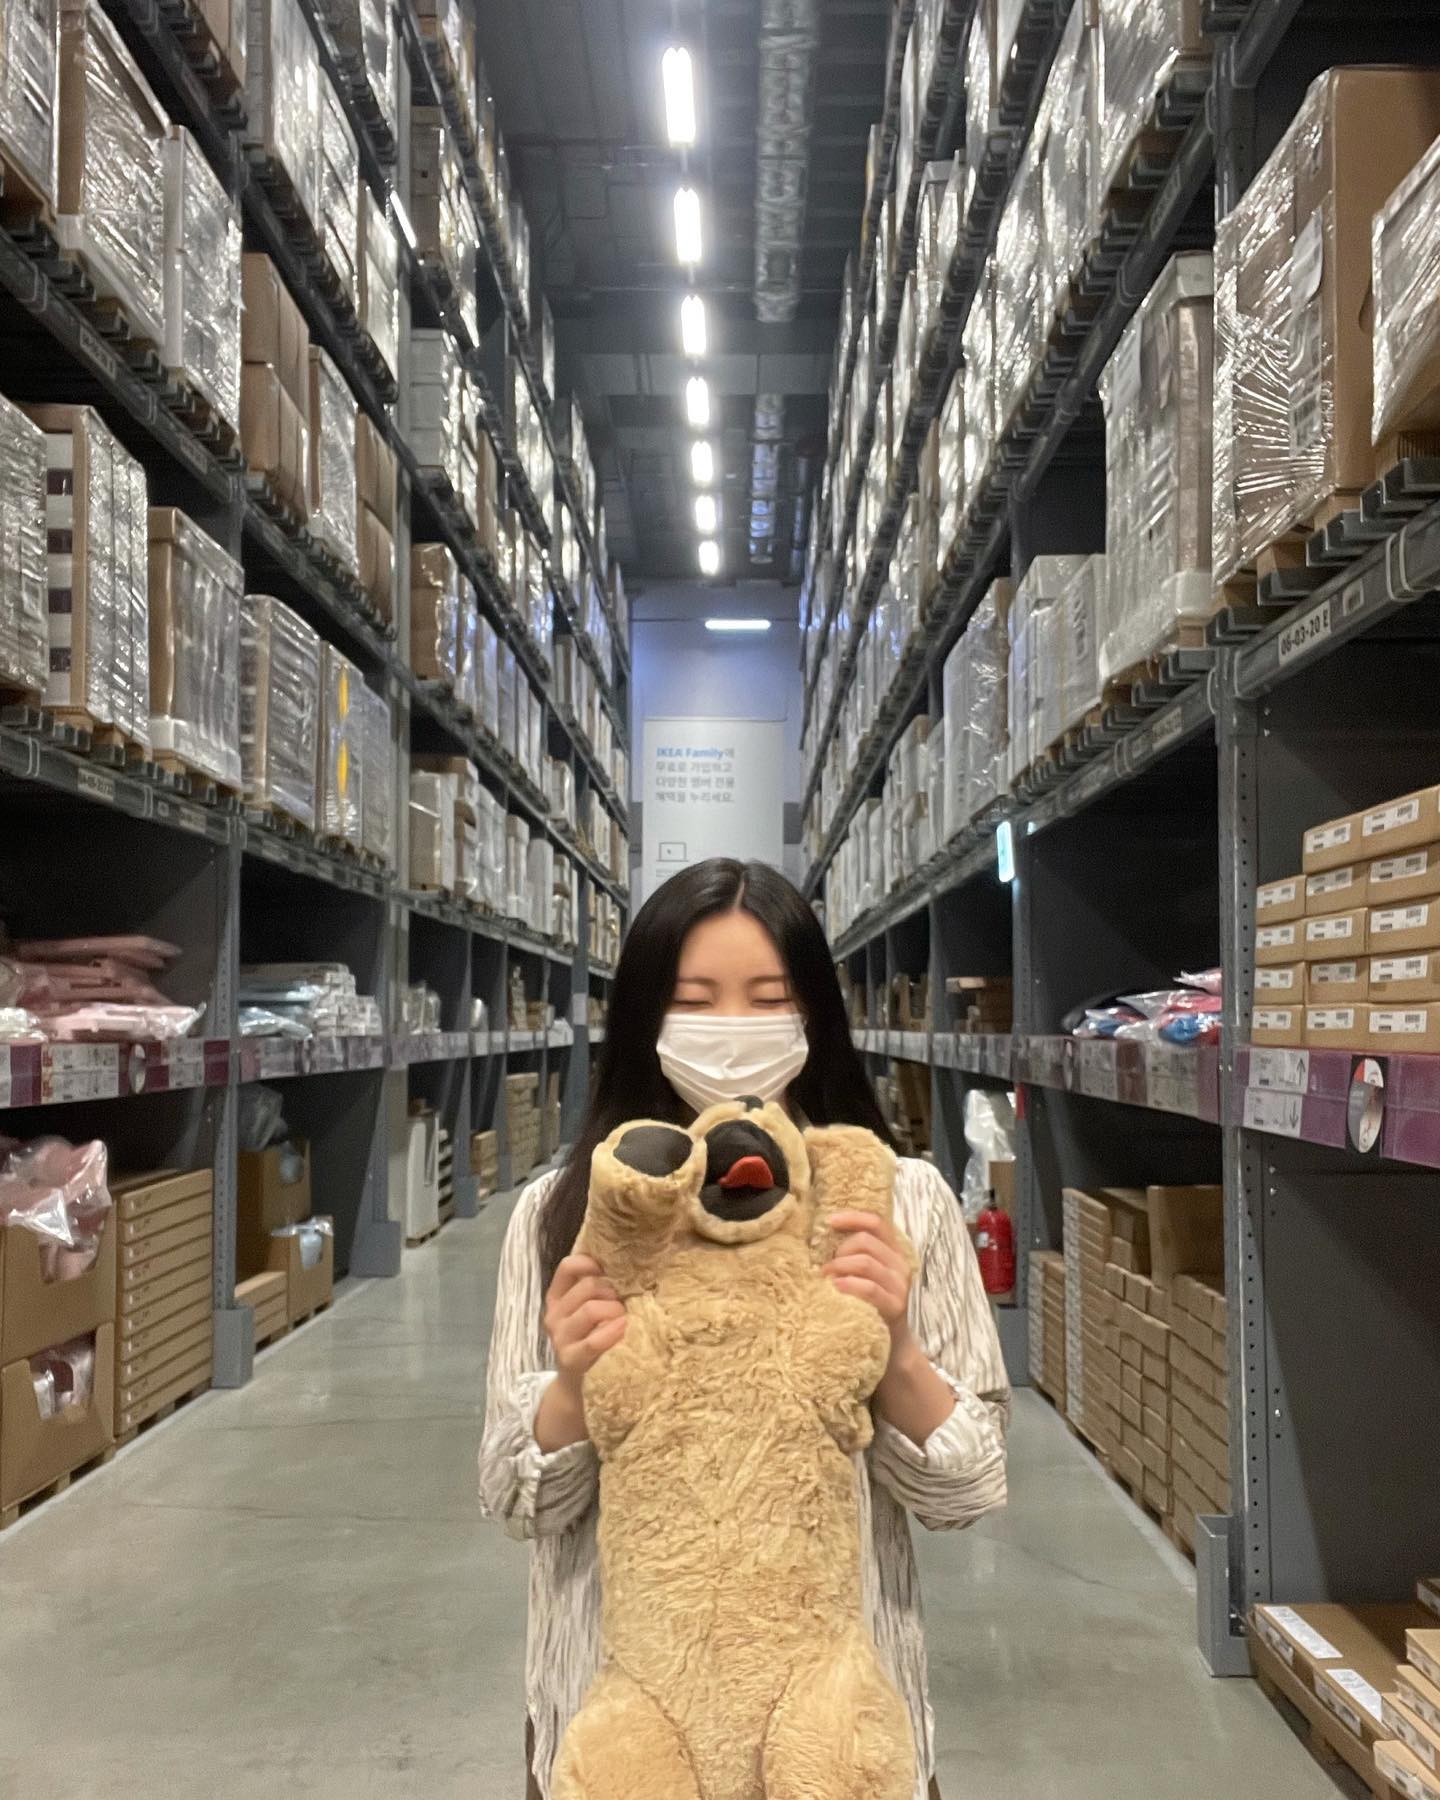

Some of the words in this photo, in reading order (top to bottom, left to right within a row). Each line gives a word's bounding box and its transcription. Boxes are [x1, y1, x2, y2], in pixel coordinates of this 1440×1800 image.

[656, 747, 683, 758] IKEA
[656, 761, 687, 772] 무료로
[690, 761, 732, 773] 가입하고
[656, 776, 687, 788] 다양한
[690, 776, 711, 788] 멤버
[715, 776, 735, 788] 전용
[655, 791, 686, 803] 혜택을
